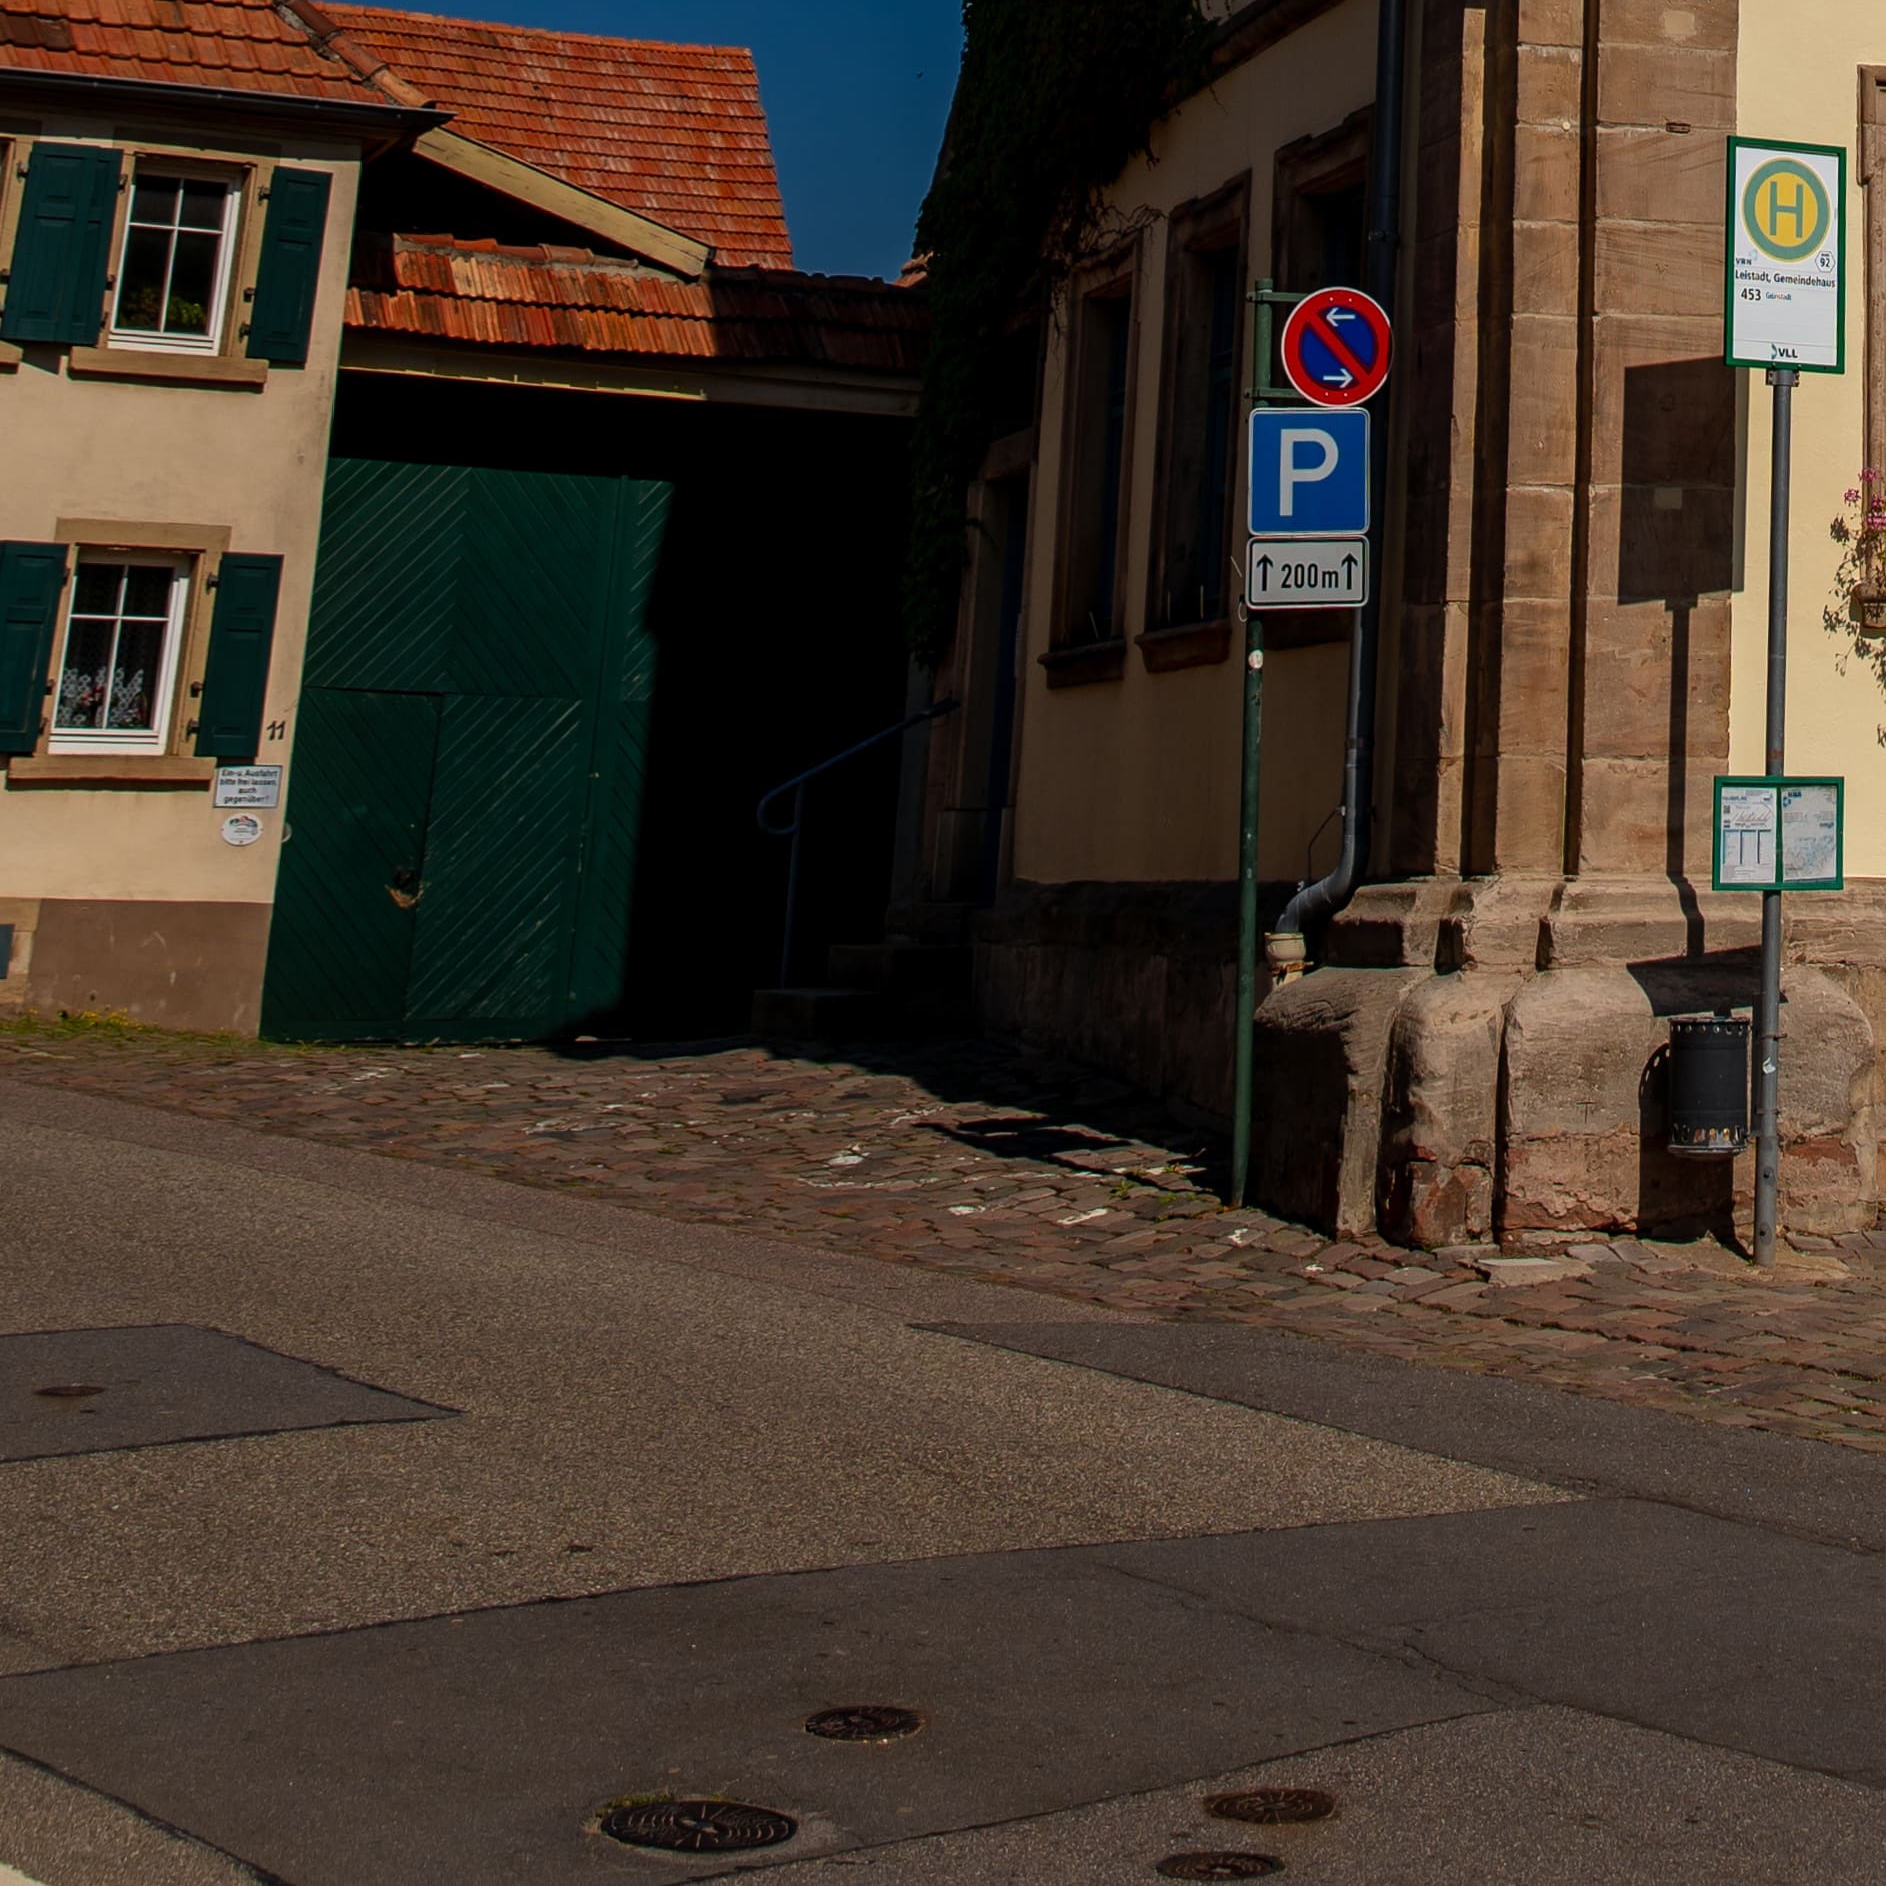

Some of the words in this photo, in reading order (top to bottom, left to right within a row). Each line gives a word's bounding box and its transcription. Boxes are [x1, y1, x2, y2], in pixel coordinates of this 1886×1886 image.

[1769, 180, 1804, 239] H
[1735, 257, 1752, 266] VRN
[1819, 258, 1831, 268] 92
[1735, 269, 1772, 283] Leistadt,
[1773, 273, 1836, 288] Gemeindehaus
[1740, 288, 1762, 301] 453
[1777, 346, 1799, 359] VLL
[1279, 428, 1340, 517] P
[266, 720, 286, 741] 11
